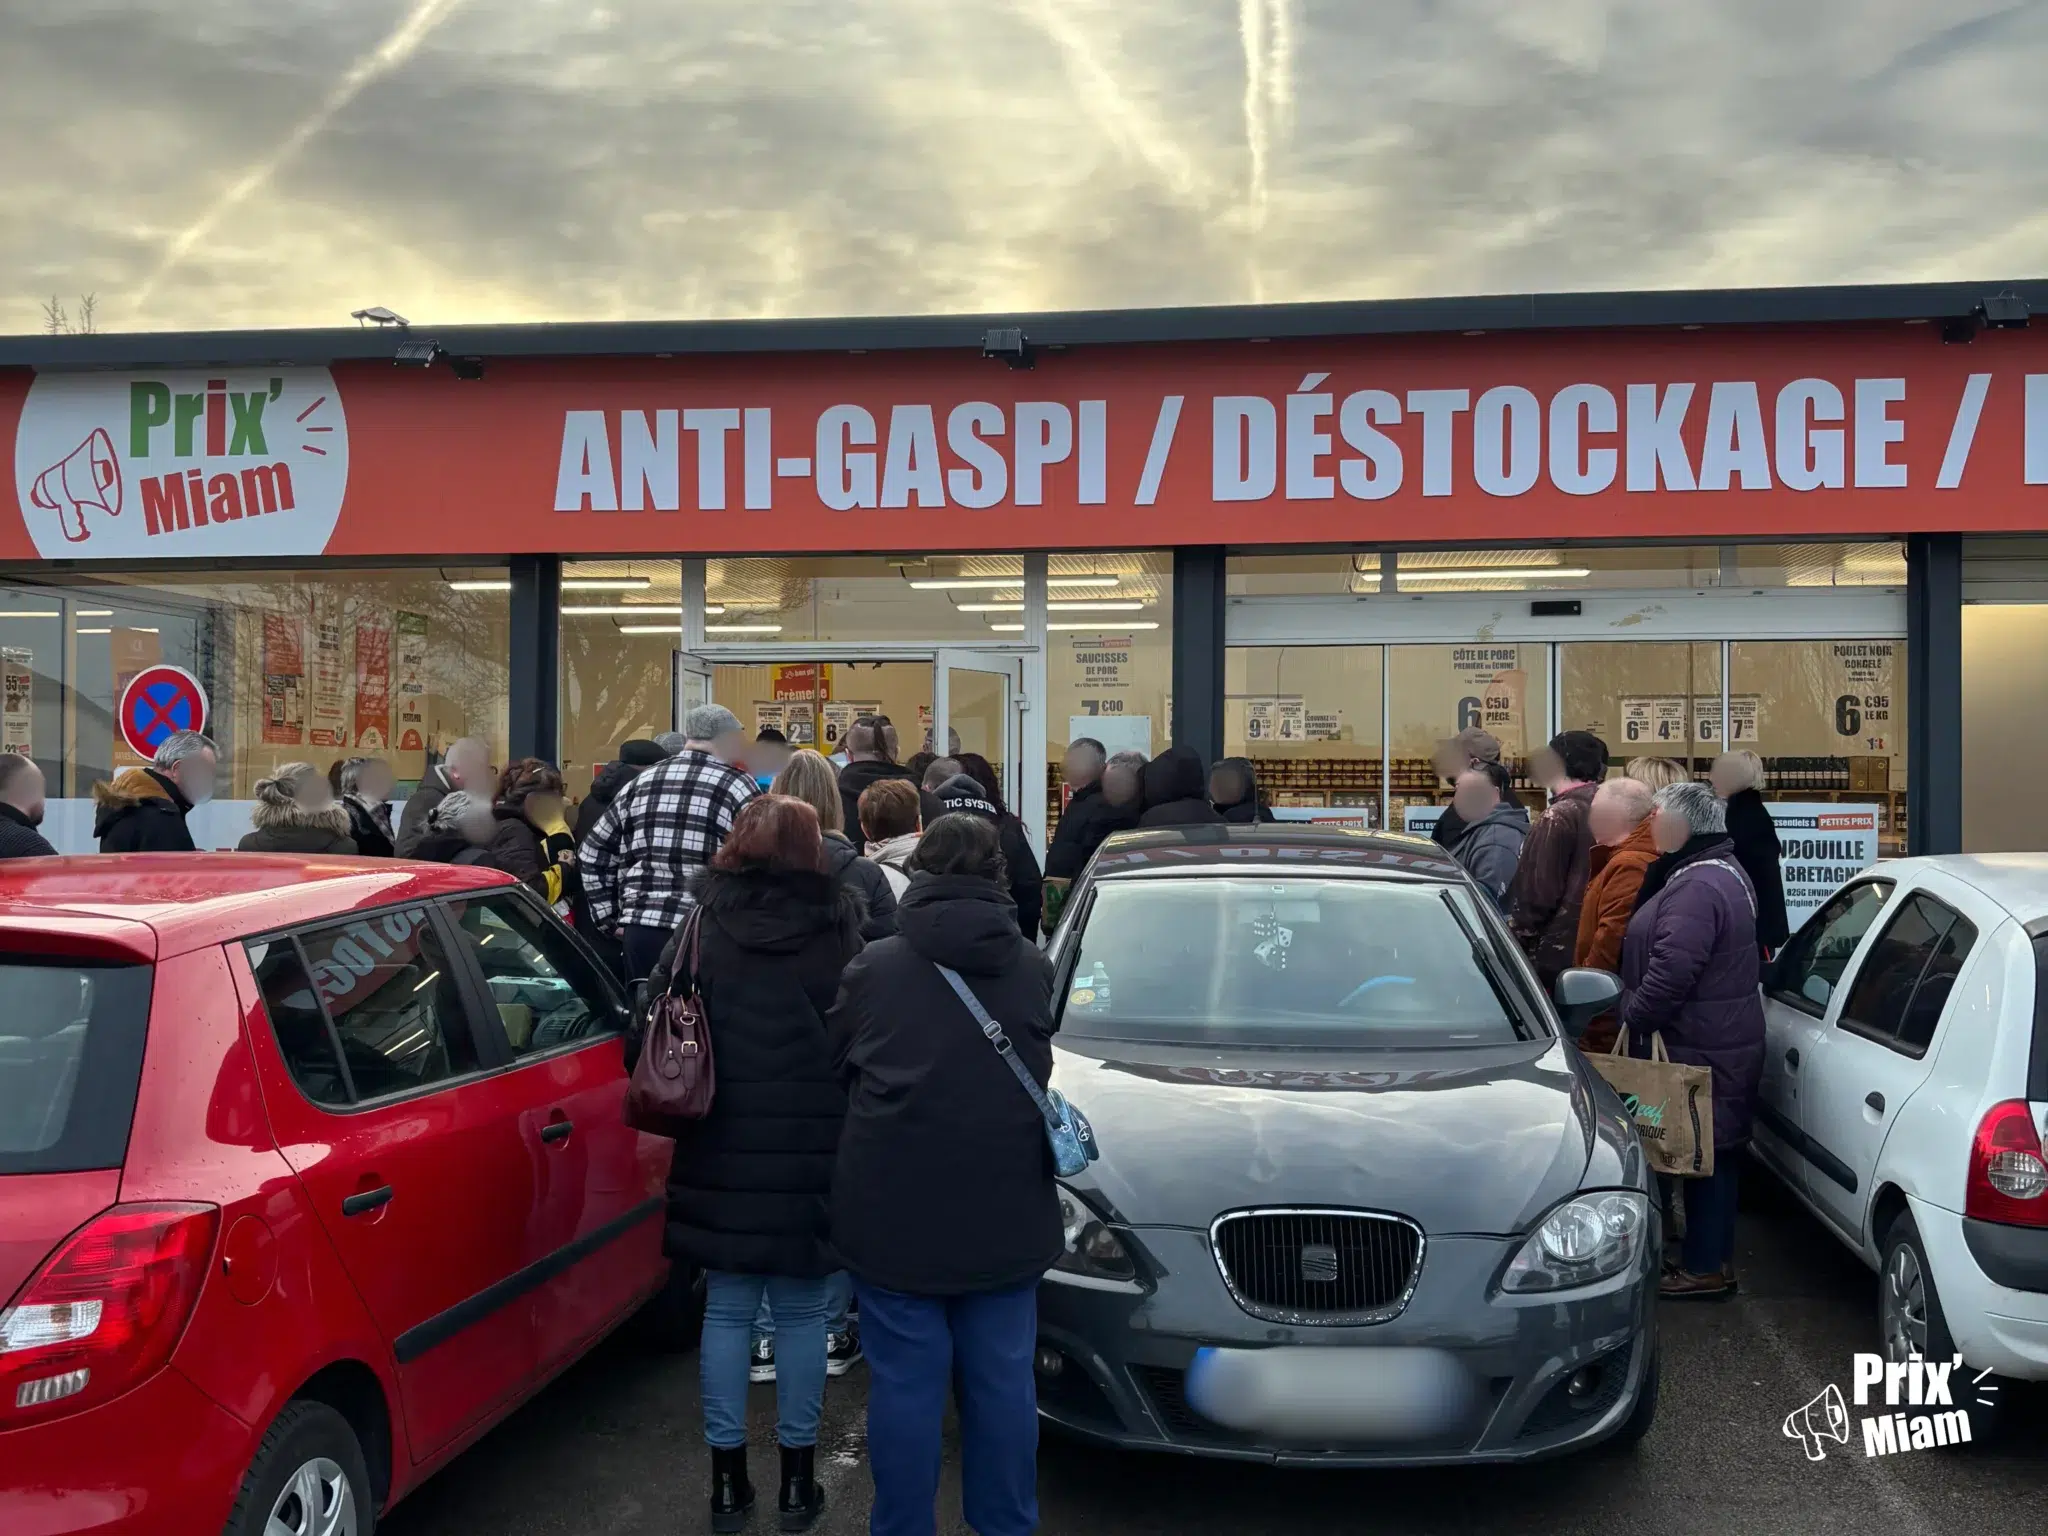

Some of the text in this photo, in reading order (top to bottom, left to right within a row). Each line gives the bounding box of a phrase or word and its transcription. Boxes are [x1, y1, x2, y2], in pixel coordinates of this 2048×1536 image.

[130, 378, 283, 458] Prix'
[553, 400, 1107, 511] ANTI-GASPI
[1134, 395, 1185, 505] /
[1212, 372, 1907, 501] DÉSTOCKAGE
[1935, 373, 1992, 489] /
[140, 461, 295, 536] Miam
[1076, 653, 1128, 663] SAUCISSES
[1453, 648, 1515, 660] CÔTE DE PORC
[1834, 645, 1892, 656] POULET NOIR
[1086, 666, 1118, 675] DE PORC
[1101, 700, 1123, 712] €00
[1458, 696, 1509, 732] 6 €50
[1836, 695, 1889, 736] 6 €95
[1865, 710, 1888, 720] LE KG
[790, 723, 801, 743] 2
[826, 724, 837, 741] 8
[1249, 719, 1261, 738] 9
[1280, 719, 1291, 738] 4
[1627, 721, 1639, 740] 6
[1658, 720, 1670, 740] 4
[1700, 720, 1712, 739] 6
[1733, 720, 1742, 738] 7
[1343, 820, 1362, 828] PRIX
[1412, 821, 1424, 830] Les
[1774, 818, 1809, 827] ssentiels
[1820, 817, 1850, 827] PETITS
[1852, 817, 1873, 826] PRIX
[1808, 888, 1836, 897] ENVIRO
[1786, 900, 1812, 908] Origine
